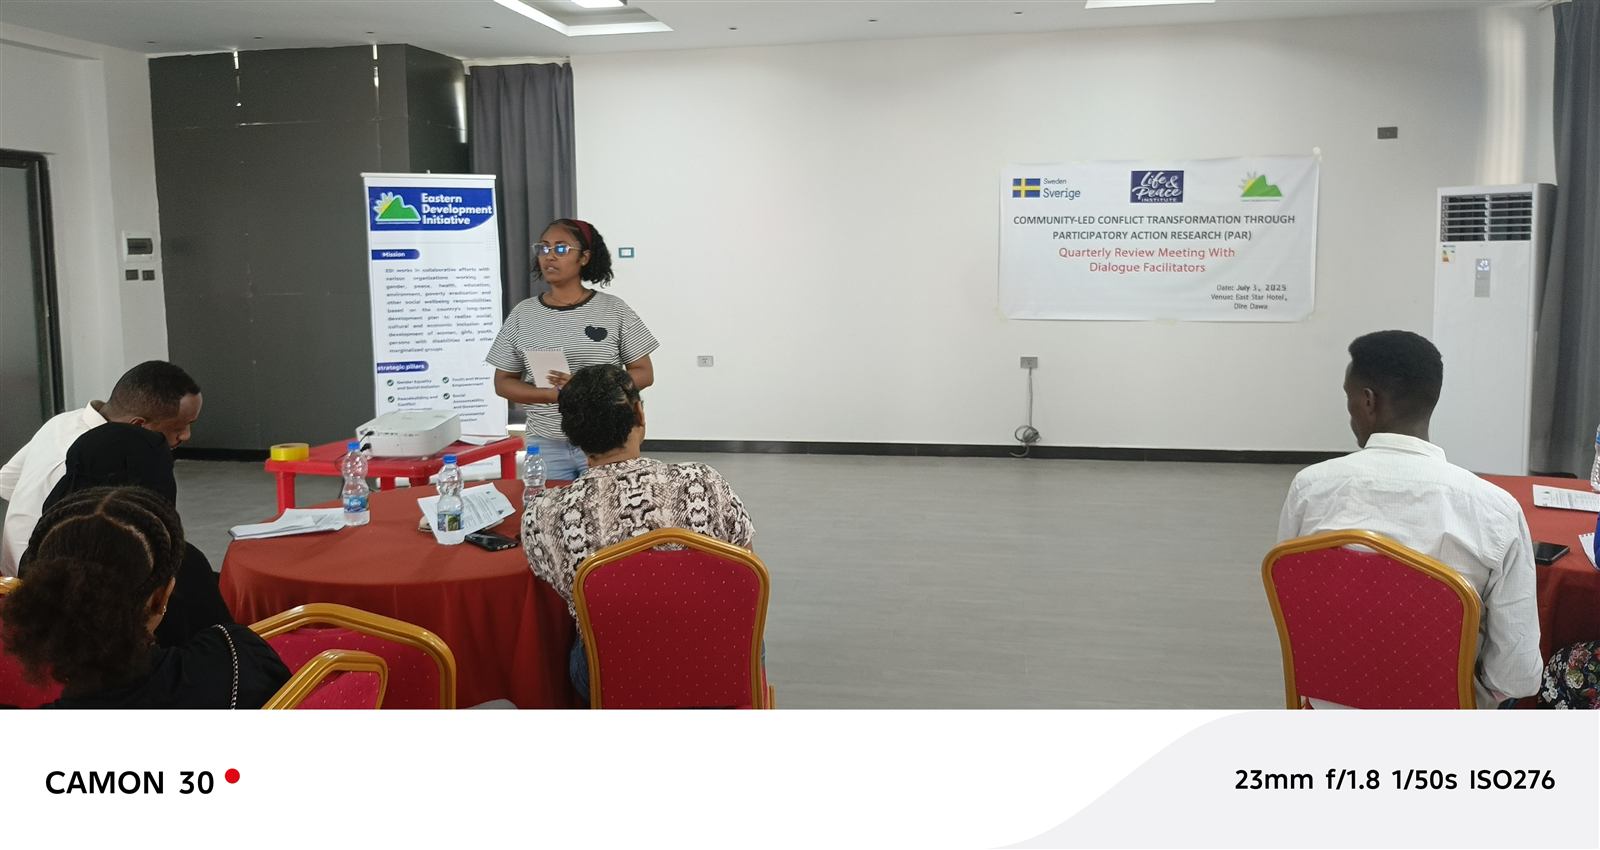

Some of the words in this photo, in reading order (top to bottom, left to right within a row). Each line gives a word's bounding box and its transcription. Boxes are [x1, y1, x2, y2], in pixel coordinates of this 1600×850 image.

[1141, 172, 1166, 188] Life
[1165, 176, 1179, 188] &
[421, 193, 462, 203] Eastern
[1043, 188, 1081, 200] Sverige
[1132, 186, 1181, 200] Peace
[422, 204, 492, 216] Development
[422, 215, 471, 224] Initiative
[1013, 216, 1095, 224] COMMUNITY-LED
[1098, 216, 1144, 224] CONFLICT
[1148, 215, 1241, 224] TRANSFORMATION
[1245, 215, 1295, 224] THROUGH
[1053, 231, 1128, 240] PARTICIPATORY
[1131, 231, 1168, 240] ACTION
[1170, 231, 1221, 240] RESEARCH
[1224, 231, 1252, 241] (PAR)
[1059, 247, 1111, 260] Quarterly
[1114, 248, 1154, 258] Review
[1157, 248, 1205, 260] Meeting
[1208, 247, 1235, 258] With
[1089, 262, 1140, 275] Dialogue
[1143, 262, 1206, 273] Facilitators
[1236, 284, 1250, 292] July
